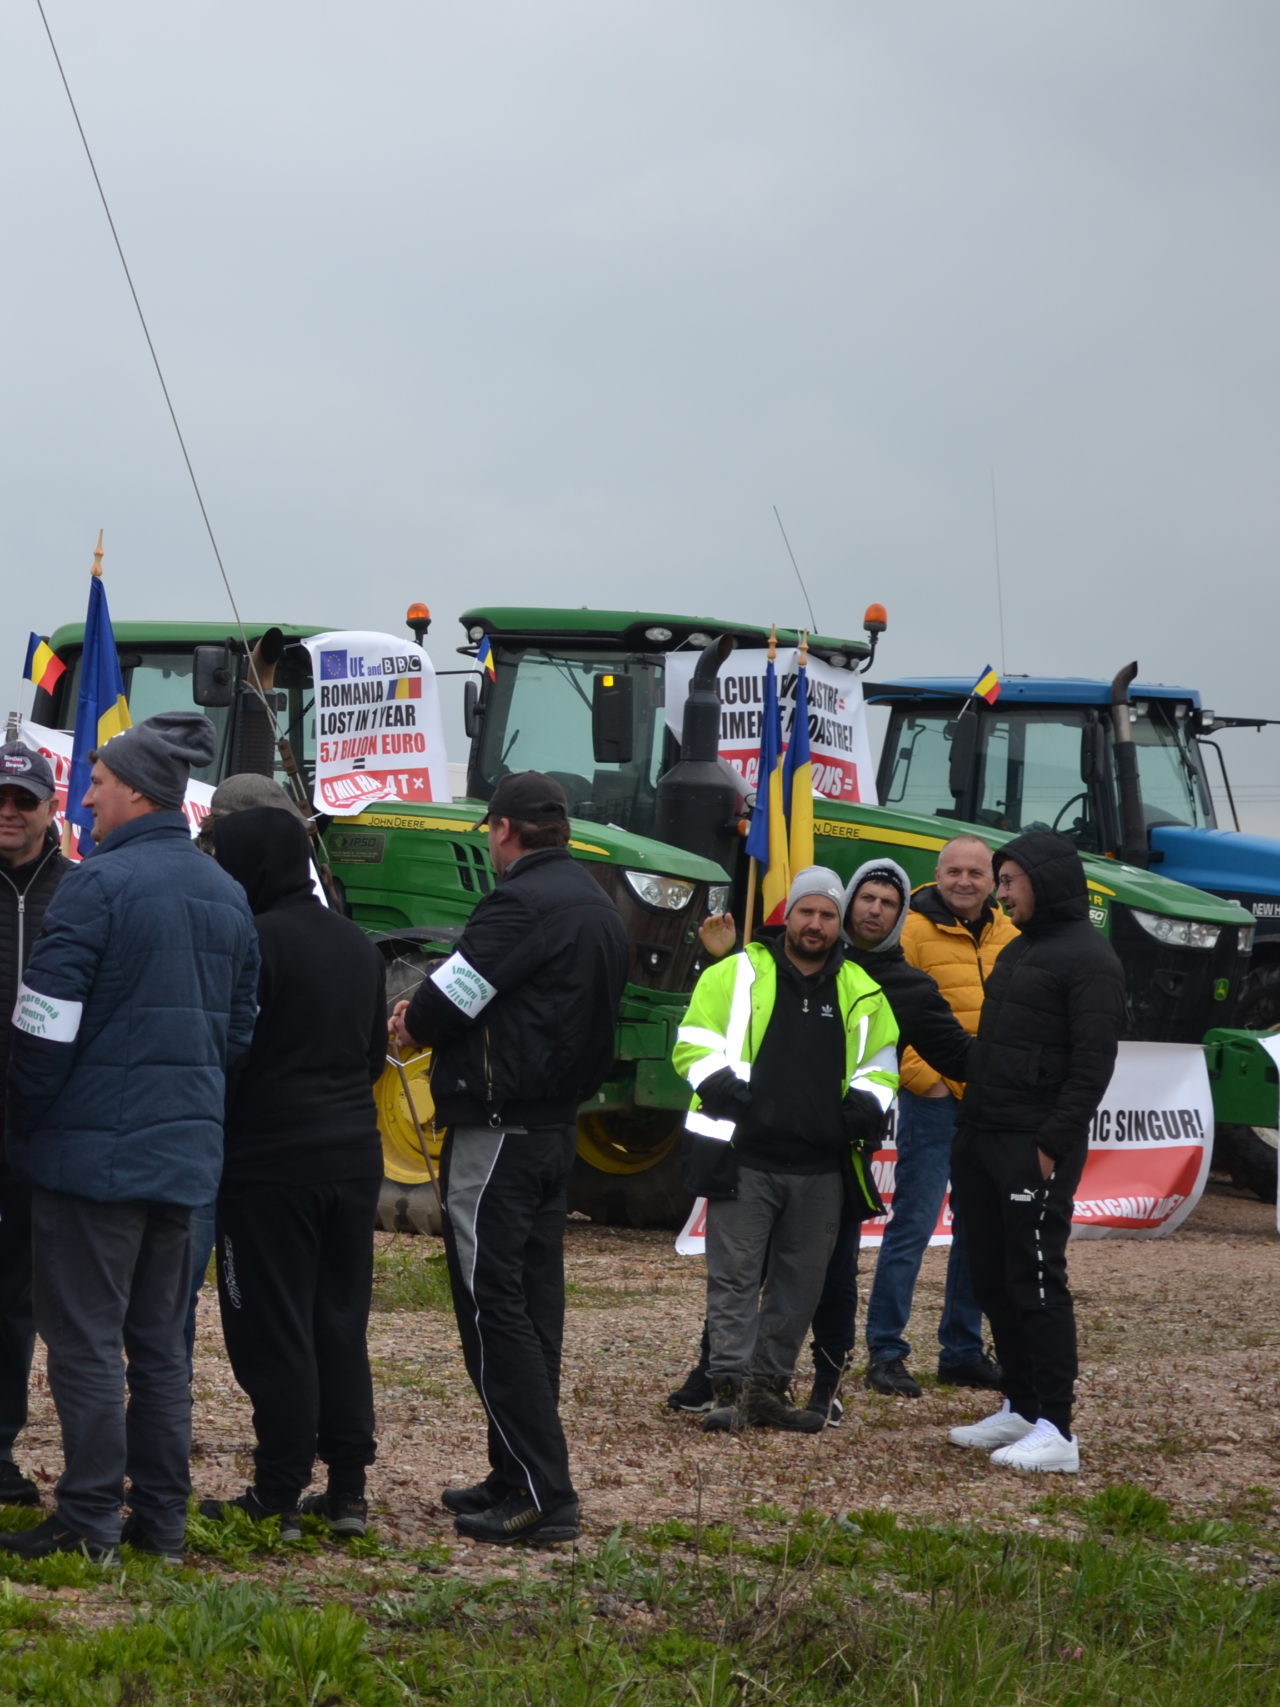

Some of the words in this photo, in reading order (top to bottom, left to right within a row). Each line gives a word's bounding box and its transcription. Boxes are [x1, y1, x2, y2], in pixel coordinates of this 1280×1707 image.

[349, 656, 365, 678] UE
[367, 663, 382, 676] and
[382, 655, 422, 675] BBC
[320, 681, 384, 708] ROMANIA
[320, 711, 355, 736] LOST
[355, 709, 370, 732] IN
[371, 709, 379, 730] 1
[378, 704, 417, 729] YEAR
[320, 740, 339, 763] 5.7
[340, 734, 378, 761] BILION
[381, 733, 426, 755] EURO
[368, 816, 393, 827] JOHN
[393, 817, 427, 829] DEERE
[822, 822, 861, 838] DEERE
[1114, 1108, 1205, 1143] SINGUR!
